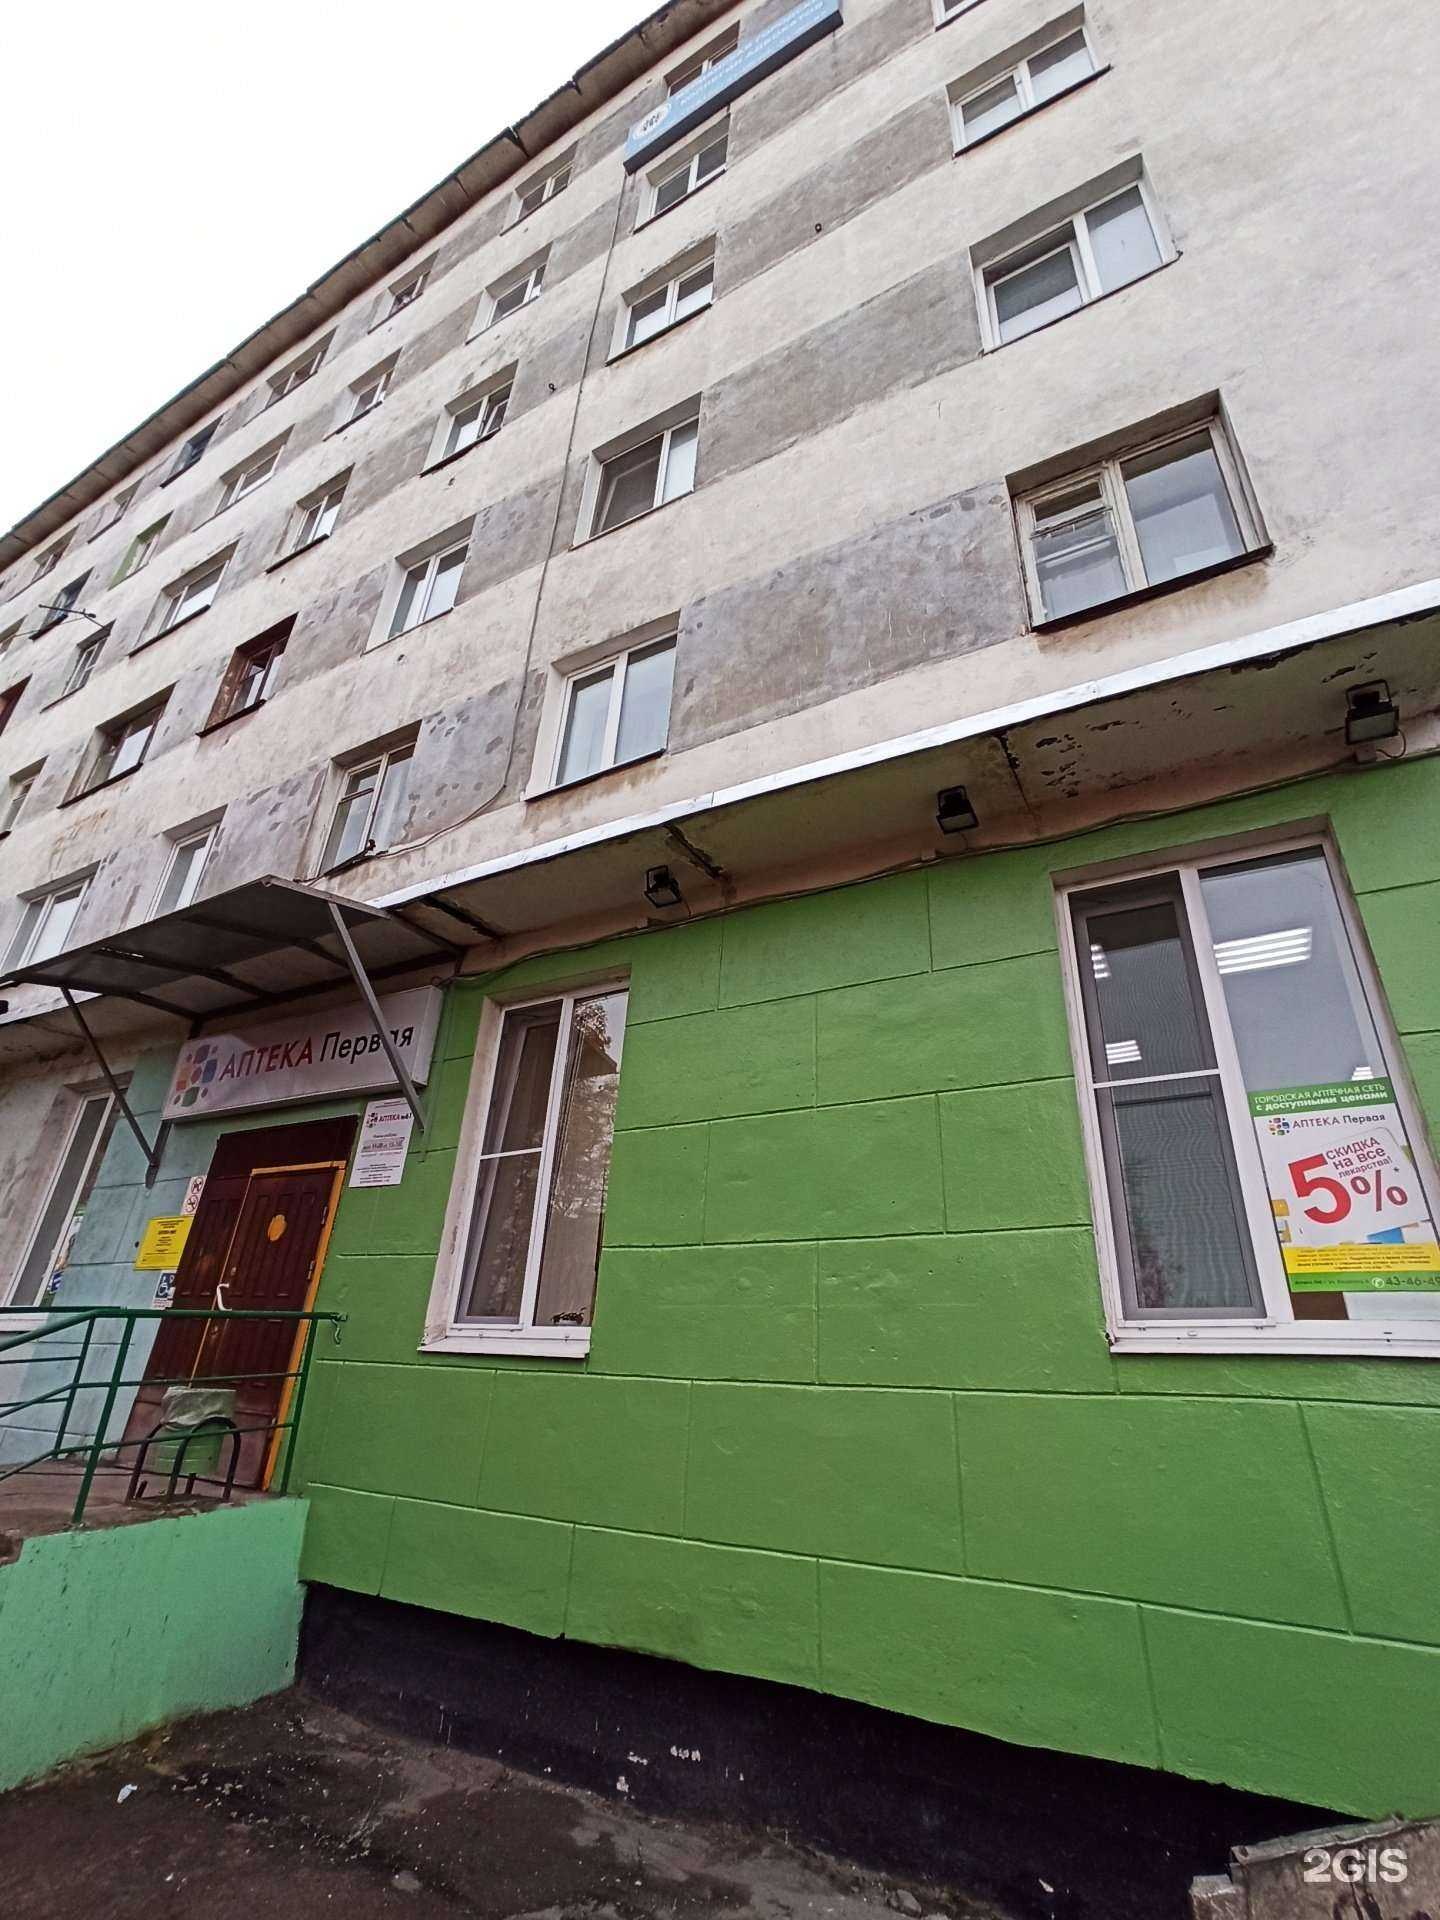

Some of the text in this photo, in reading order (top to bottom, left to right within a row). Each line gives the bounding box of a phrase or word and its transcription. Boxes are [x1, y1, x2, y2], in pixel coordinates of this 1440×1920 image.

[219, 1037, 313, 1081] АПТЕКА
[1254, 1083, 1386, 1104] ГОРОДСКАЯ АПТЕЧНАЯ СЕТЬ
[1265, 1097, 1337, 1112] доступными
[1341, 1092, 1388, 1103] ценами
[1292, 1115, 1386, 1129] АПТЕКА Первая
[1326, 1137, 1380, 1160] СКИДКА
[1333, 1147, 1386, 1170] на все
[1339, 1156, 1393, 1179] лекарства!
